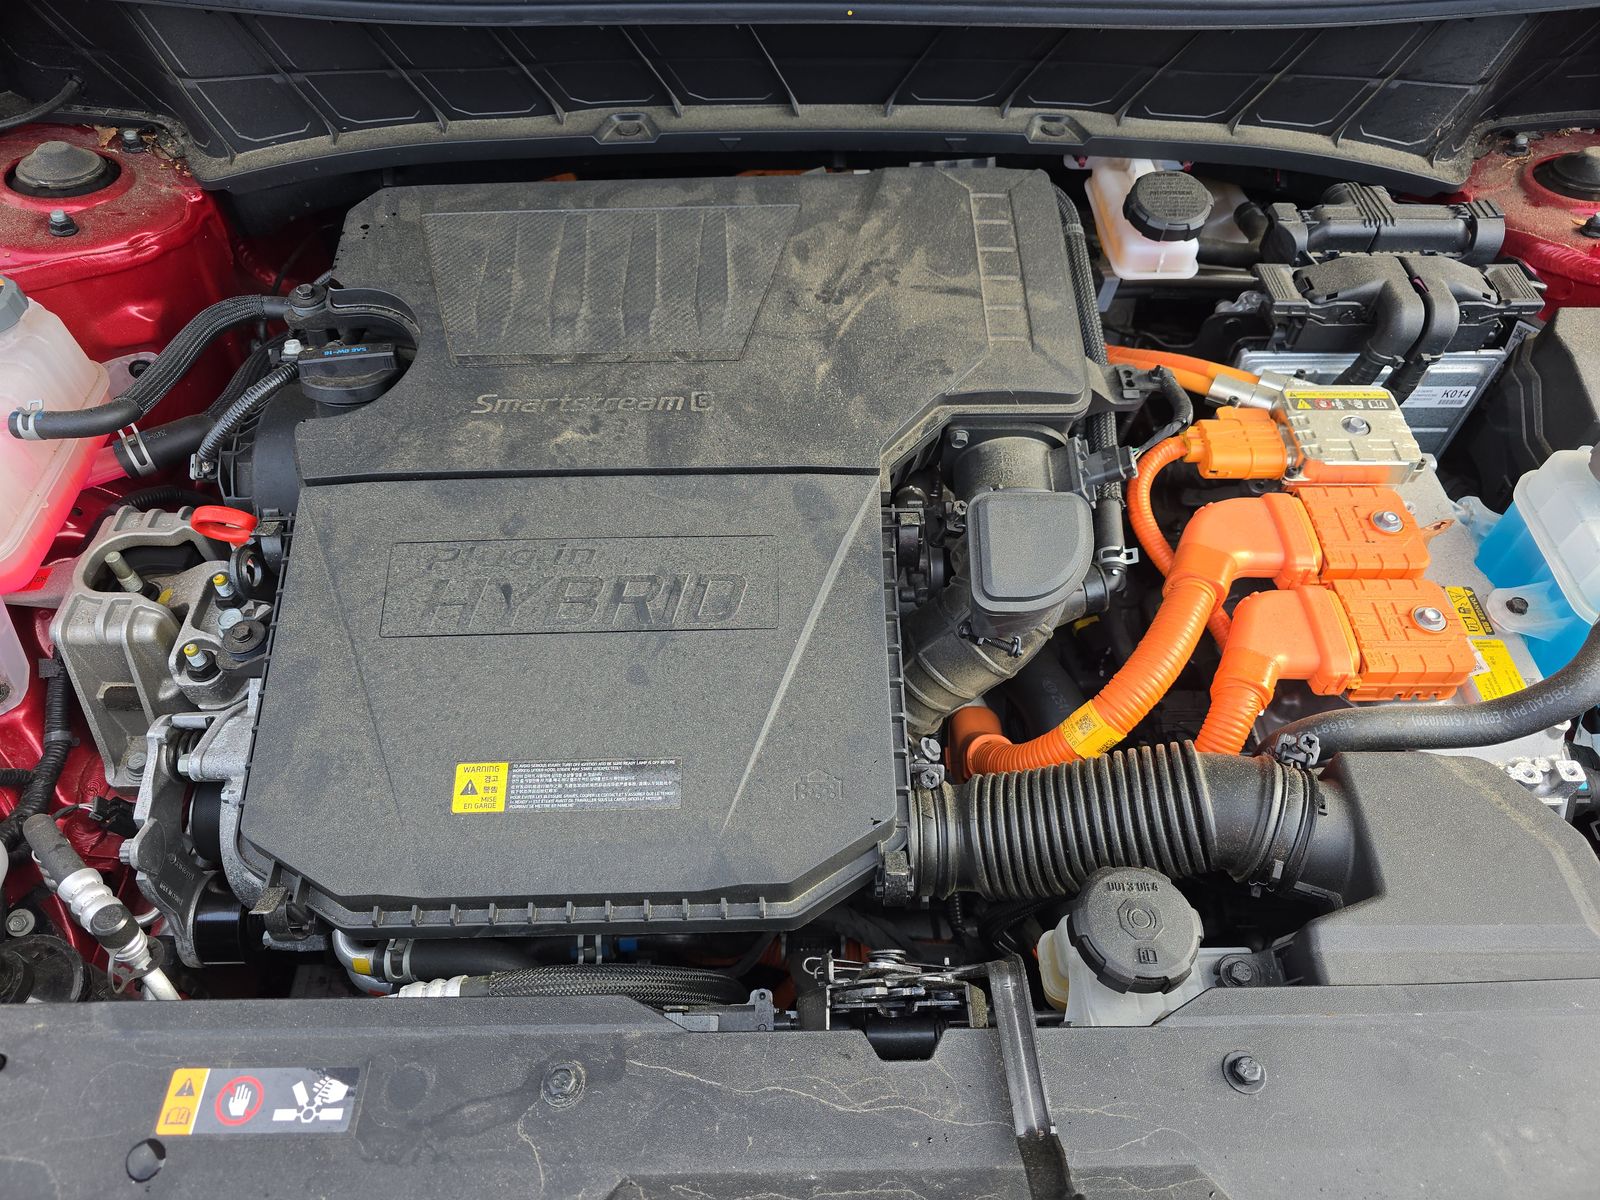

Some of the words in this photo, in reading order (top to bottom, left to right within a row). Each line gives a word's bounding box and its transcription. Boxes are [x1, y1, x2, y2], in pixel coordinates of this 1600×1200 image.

[1441, 389, 1471, 398] K014
[470, 393, 685, 414] Smartstream
[421, 573, 749, 627] HYBRID
[463, 765, 500, 773] WARNING
[1151, 882, 1159, 892] 4
